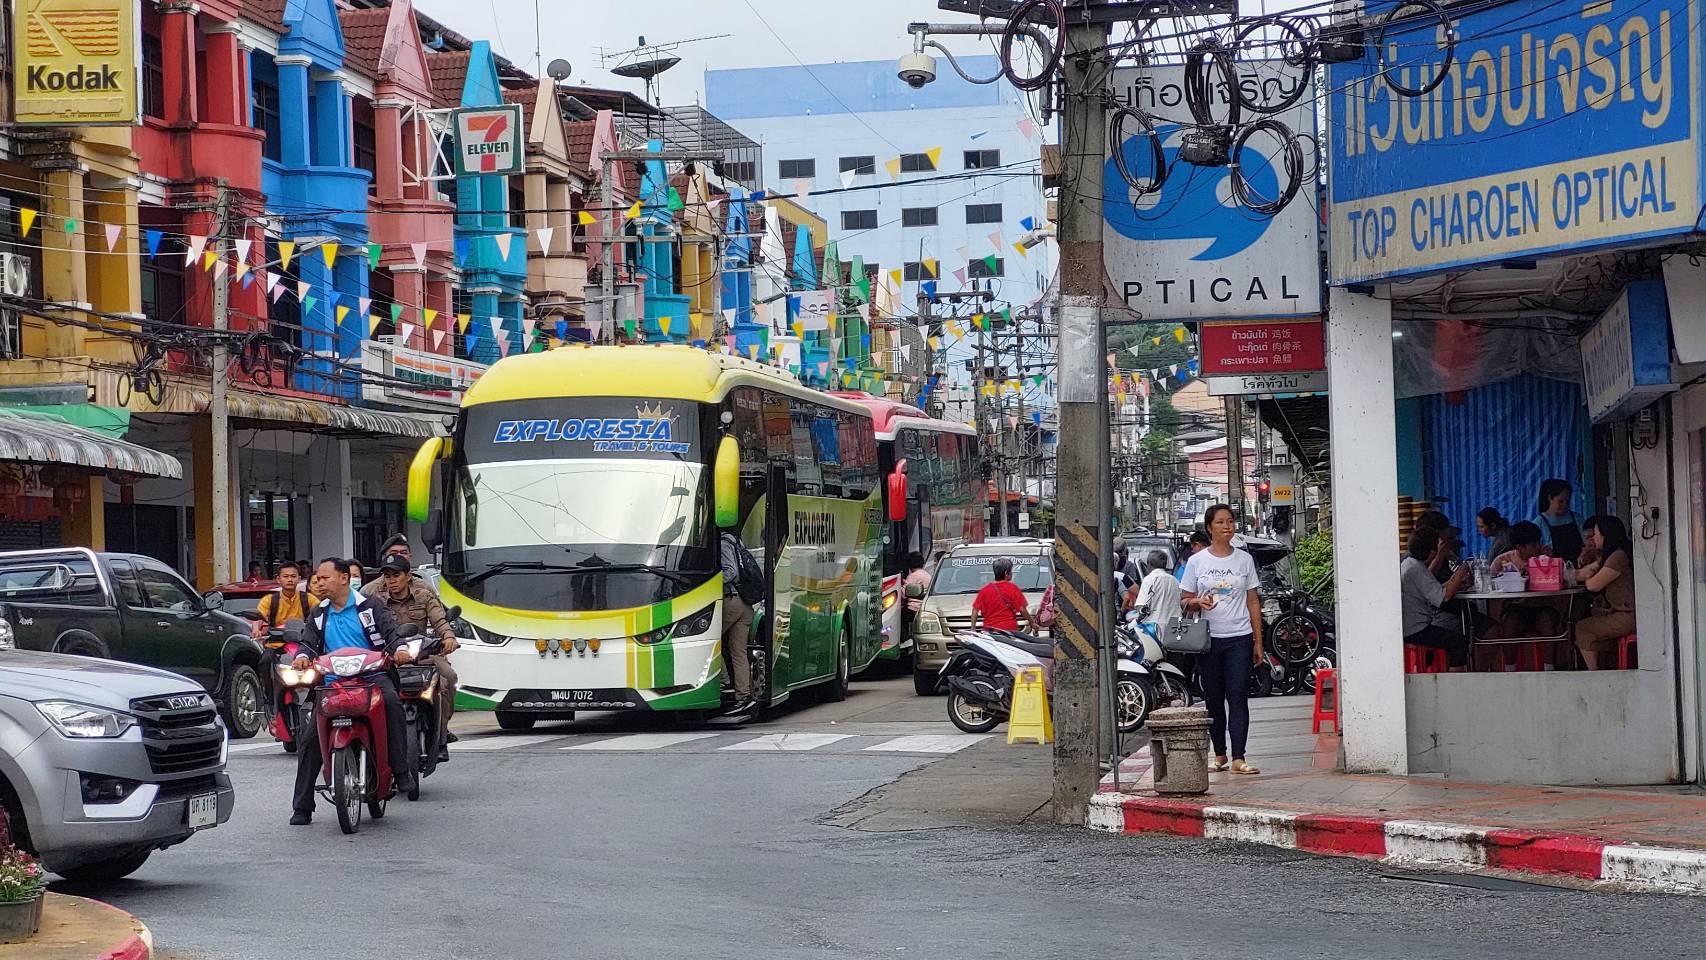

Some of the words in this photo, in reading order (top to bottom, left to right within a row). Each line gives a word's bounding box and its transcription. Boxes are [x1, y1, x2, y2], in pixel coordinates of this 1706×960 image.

[27, 63, 122, 92] Kodak
[467, 115, 508, 172] 7
[1348, 206, 1397, 262] TOP
[1411, 178, 1540, 252] CHAROEN
[1552, 156, 1677, 230] OPTICAL
[1102, 275, 1300, 307] PTICAL
[1272, 341, 1302, 351] 肉骨茶
[493, 418, 672, 443] EXPLORESIA
[594, 441, 637, 452] TRAVEL
[651, 443, 690, 453] TOURS
[794, 511, 836, 545] EXPLORESIA
[167, 695, 200, 710] ISUZU
[573, 690, 593, 700] 7072
